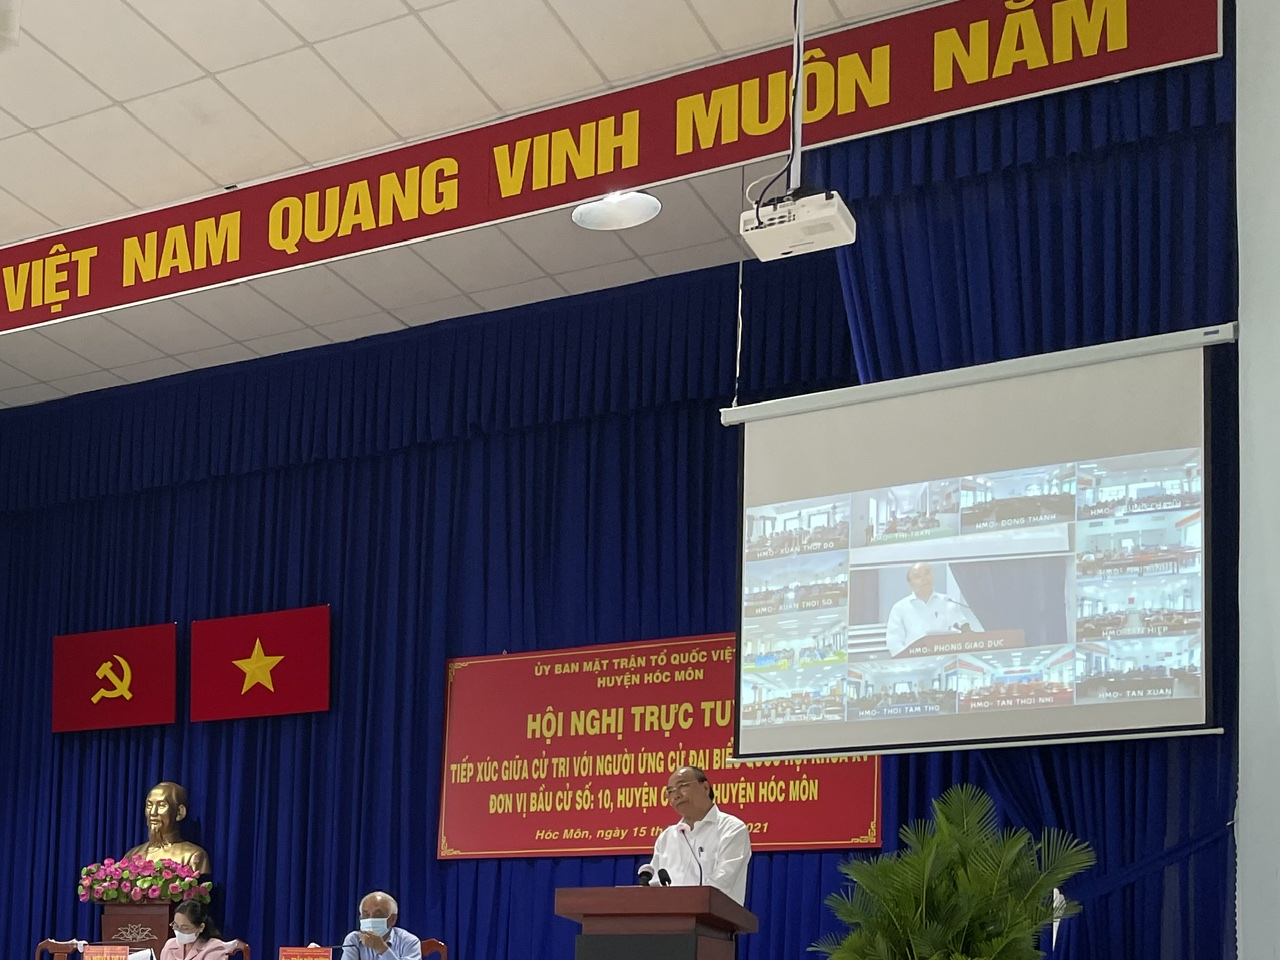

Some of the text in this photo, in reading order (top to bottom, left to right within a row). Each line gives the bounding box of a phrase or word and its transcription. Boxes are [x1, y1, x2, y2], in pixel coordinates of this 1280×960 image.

[2, 244, 98, 315] VIỆT
[122, 210, 241, 287] NAM
[267, 156, 459, 255] QUANG
[494, 112, 640, 199] VINH
[675, 45, 890, 156] MUÔN
[933, 0, 1128, 92] NĂM
[534, 646, 736, 677] ỦY BAN MẶT TRẬN TỔ QUỐC VIỆ
[934, 642, 962, 652] PHONG
[597, 667, 704, 689] HUYỆN HÓC MÔN
[1146, 688, 1172, 696] XUAN
[527, 699, 735, 745] HỘI NGHỊ TRỰC TU
[450, 755, 474, 784] TIẾP
[476, 752, 498, 783] XÚC
[501, 754, 529, 781] GIỮA
[532, 750, 549, 779] CỬ
[552, 756, 570, 778] TRI
[573, 750, 593, 777] VỚI
[596, 747, 635, 776] NGƯỜI
[638, 747, 665, 774] ỨNG
[489, 793, 513, 814] ĐƠN
[516, 793, 527, 818] VỊ
[529, 784, 552, 812] BẦU
[555, 783, 573, 811] CỬ
[575, 782, 595, 810] SỐ:
[598, 789, 614, 813] 10,
[617, 782, 658, 814] HUYỆN
[759, 775, 786, 803] HÓC
[789, 774, 819, 801] MÔN
[535, 829, 559, 840] Hóc
[562, 828, 593, 841] Môn,
[596, 827, 629, 841] ngày
[632, 826, 647, 836] 15
